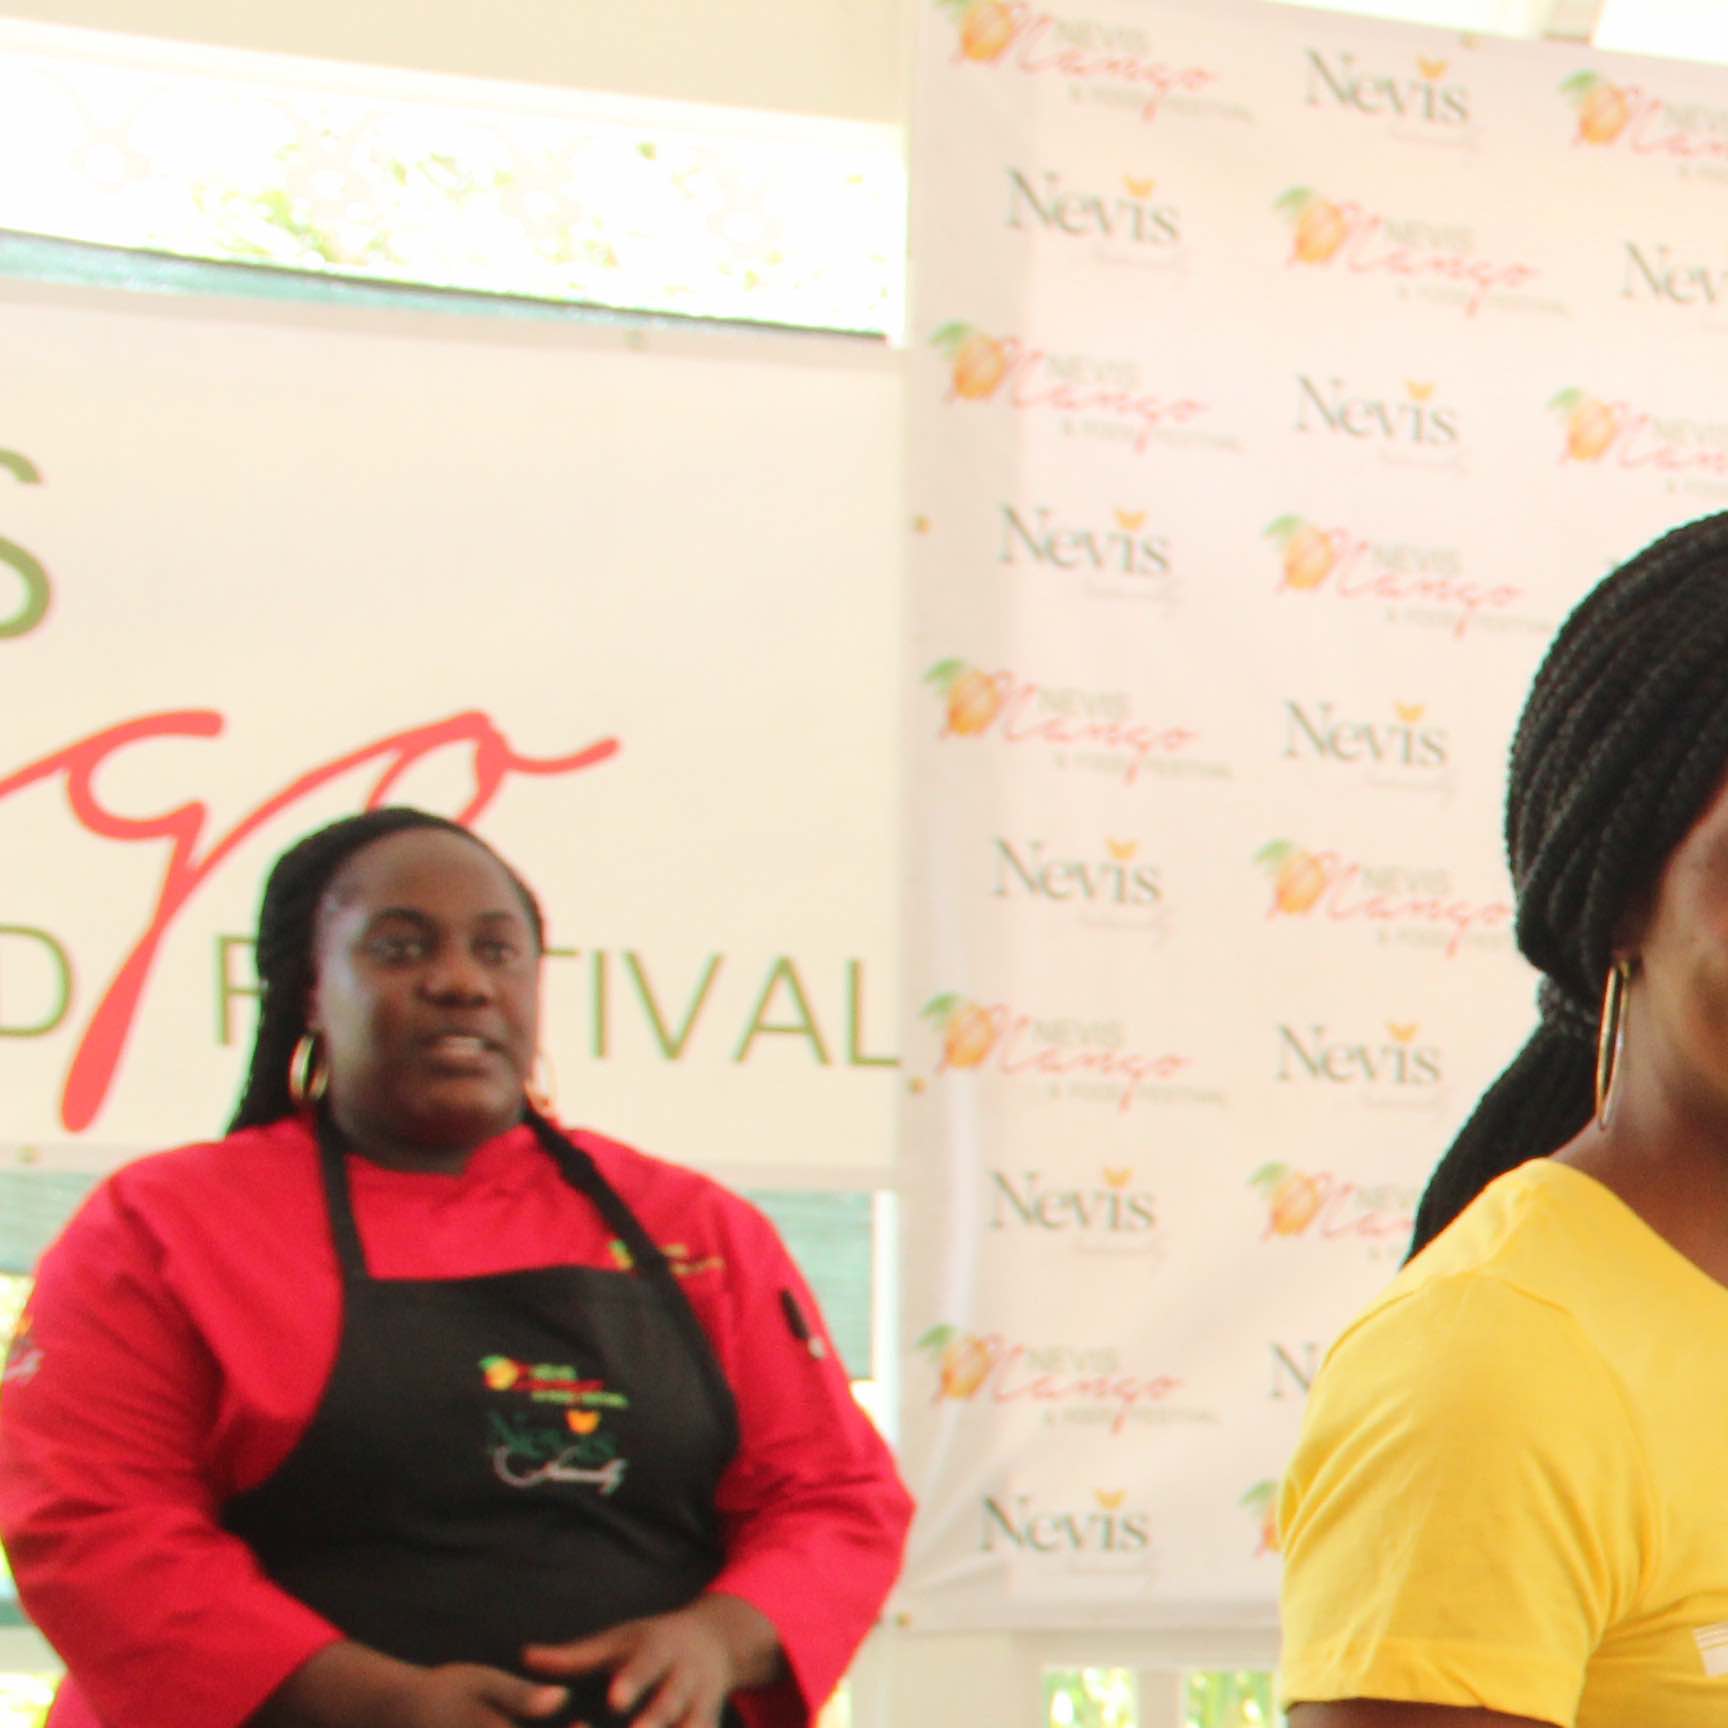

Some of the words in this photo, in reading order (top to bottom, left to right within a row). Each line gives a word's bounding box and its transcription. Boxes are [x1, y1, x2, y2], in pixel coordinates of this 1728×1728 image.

[1303, 45, 1471, 125] Nevis
[1004, 164, 1182, 245] Nevis
[1296, 373, 1460, 444] Nevis
[997, 502, 1172, 576] Nevis
[1283, 697, 1447, 767] Nevis
[992, 835, 1165, 905] Nevis
[1275, 1023, 1438, 1085] Nevis
[989, 1167, 1156, 1233] Nevis
[979, 1488, 1151, 1555] Nevis
